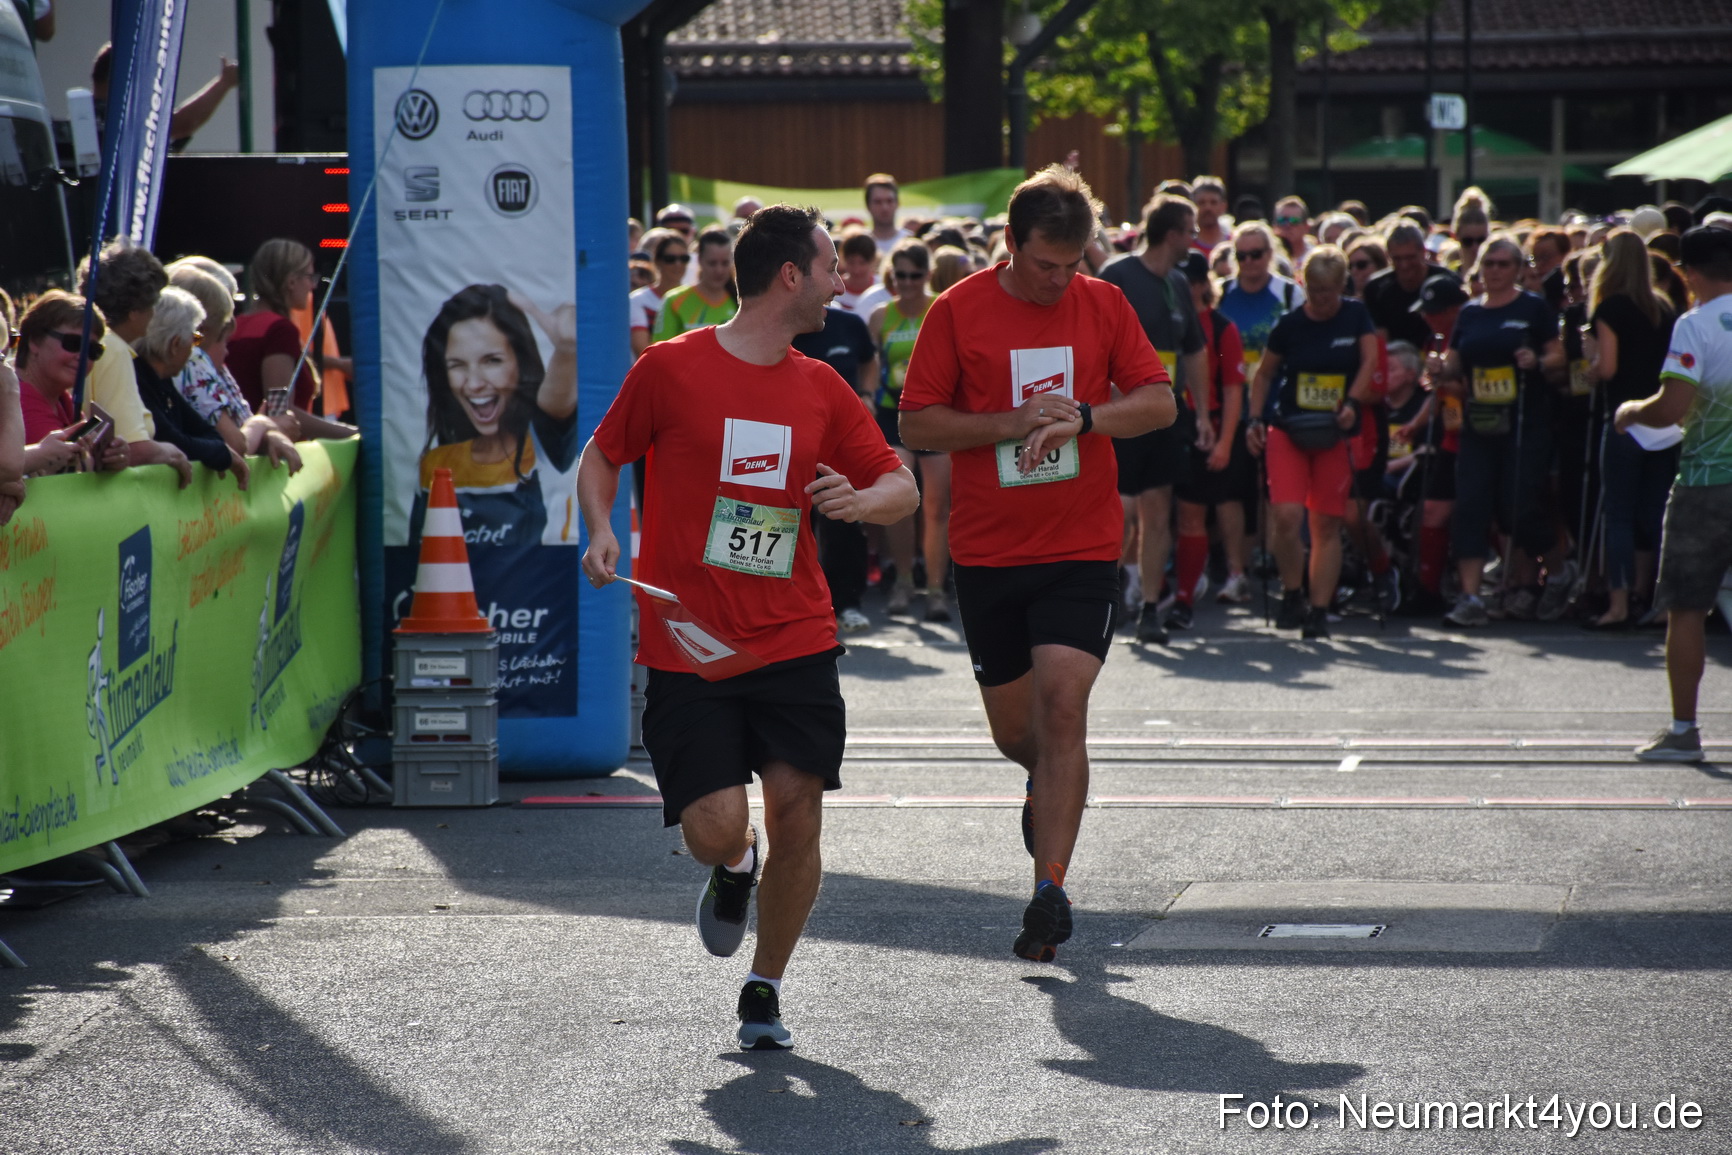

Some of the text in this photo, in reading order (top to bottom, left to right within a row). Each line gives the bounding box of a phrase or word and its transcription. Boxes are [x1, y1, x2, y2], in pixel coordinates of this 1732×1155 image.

[466, 130, 504, 141] Audi
[497, 179, 527, 203] FIAT
[394, 209, 453, 221] SEAT
[1033, 379, 1053, 393] DEHN
[1303, 387, 1339, 401] 1386
[744, 459, 768, 470] DEHN
[1037, 464, 1060, 473] Harald
[728, 526, 782, 557] 517
[729, 551, 774, 565] Meier Florian
[729, 559, 745, 567] DEHN
[108, 618, 178, 748] firmenlauf
